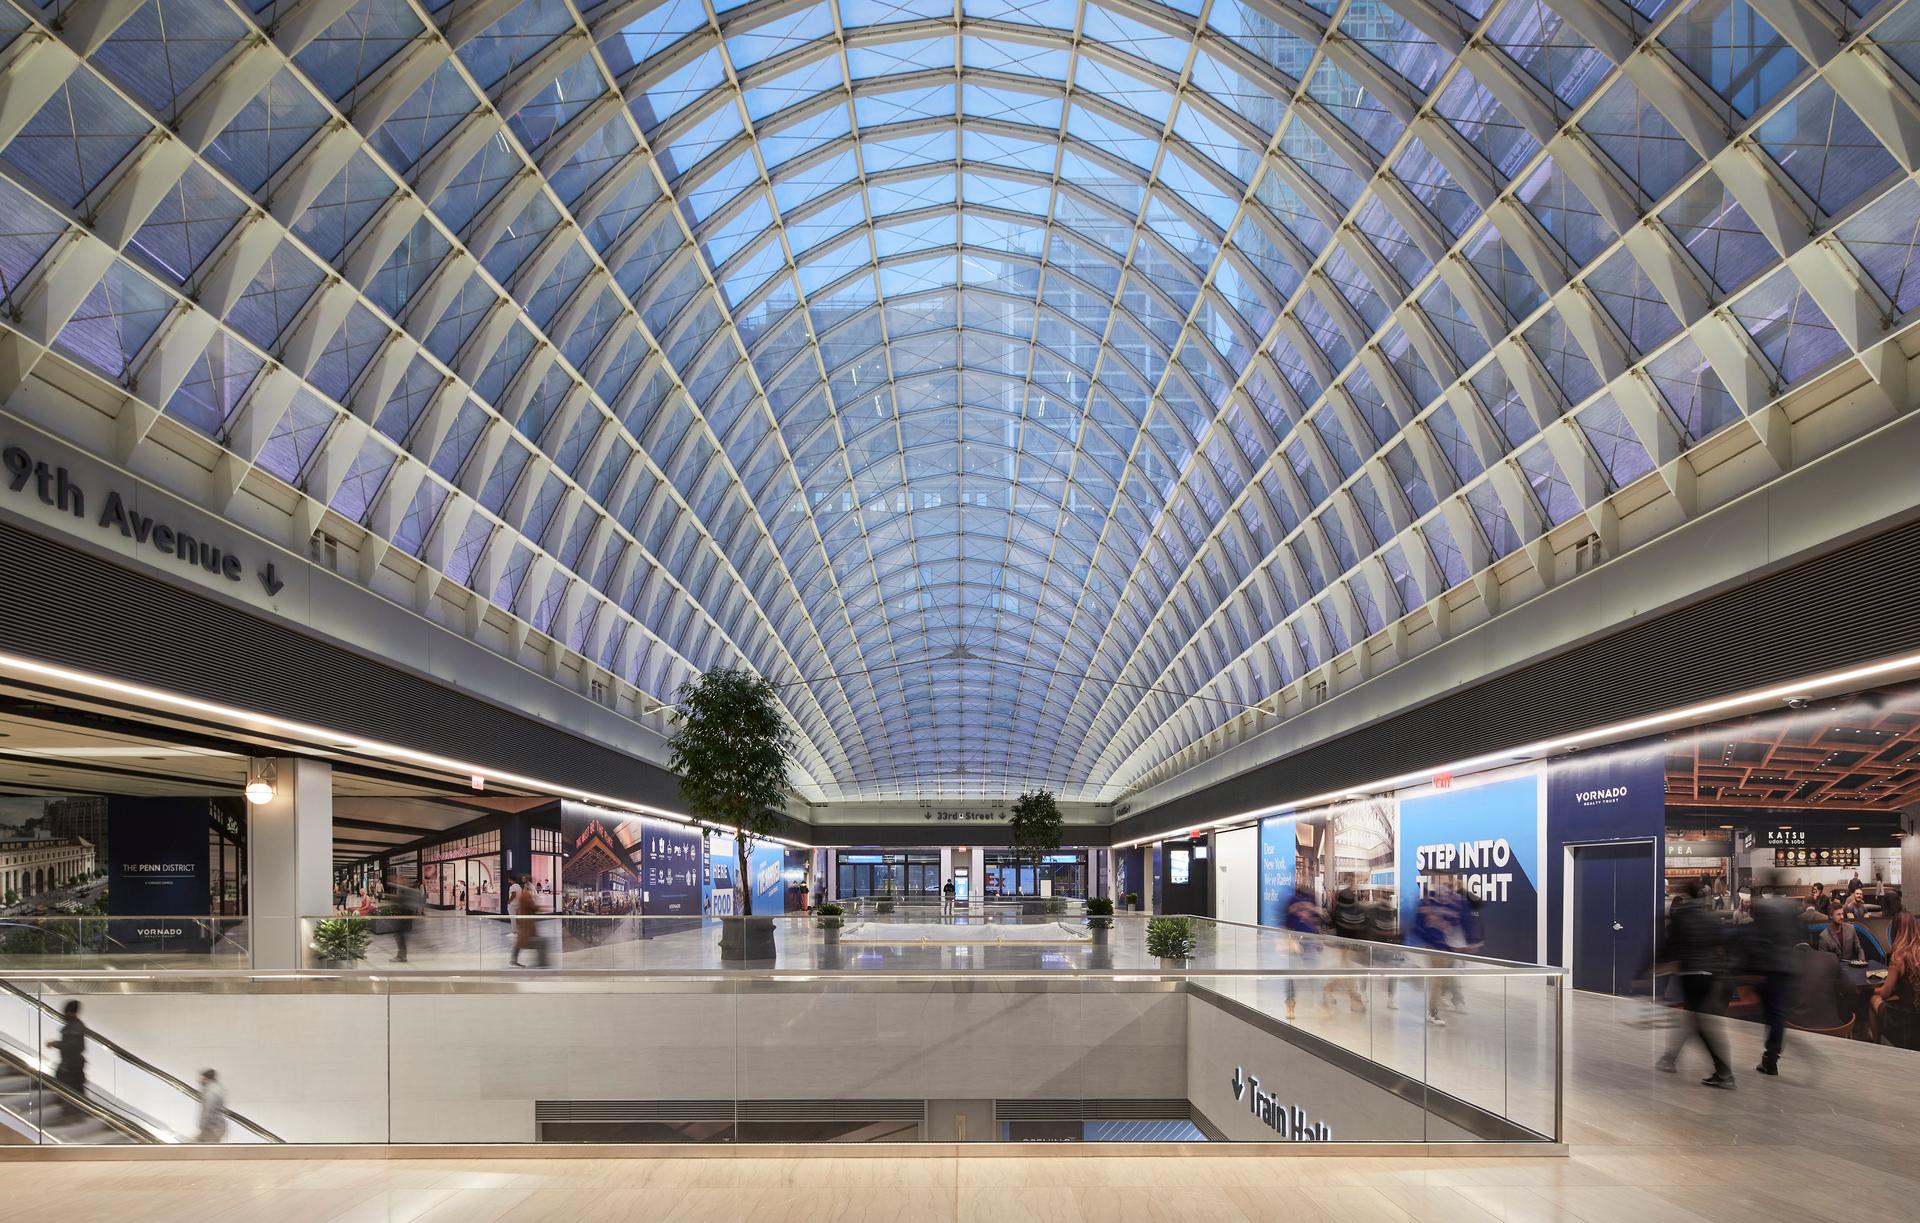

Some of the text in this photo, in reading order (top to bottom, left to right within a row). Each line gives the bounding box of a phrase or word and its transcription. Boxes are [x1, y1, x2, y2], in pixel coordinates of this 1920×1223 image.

[2, 447, 242, 581] 9th Avenue
[1575, 786, 1628, 804] VORNADO
[936, 811, 994, 820] 33rd Street
[1768, 831, 1805, 839] KATSU
[1416, 838, 1511, 871] STEP INTO
[1668, 846, 1693, 855] PEA
[123, 864, 196, 872] THE PENN DISTRICT
[713, 863, 728, 879] HERE
[713, 894, 731, 915] FOOD
[137, 928, 183, 936] VORNADO
[1247, 1076, 1288, 1138] Train
